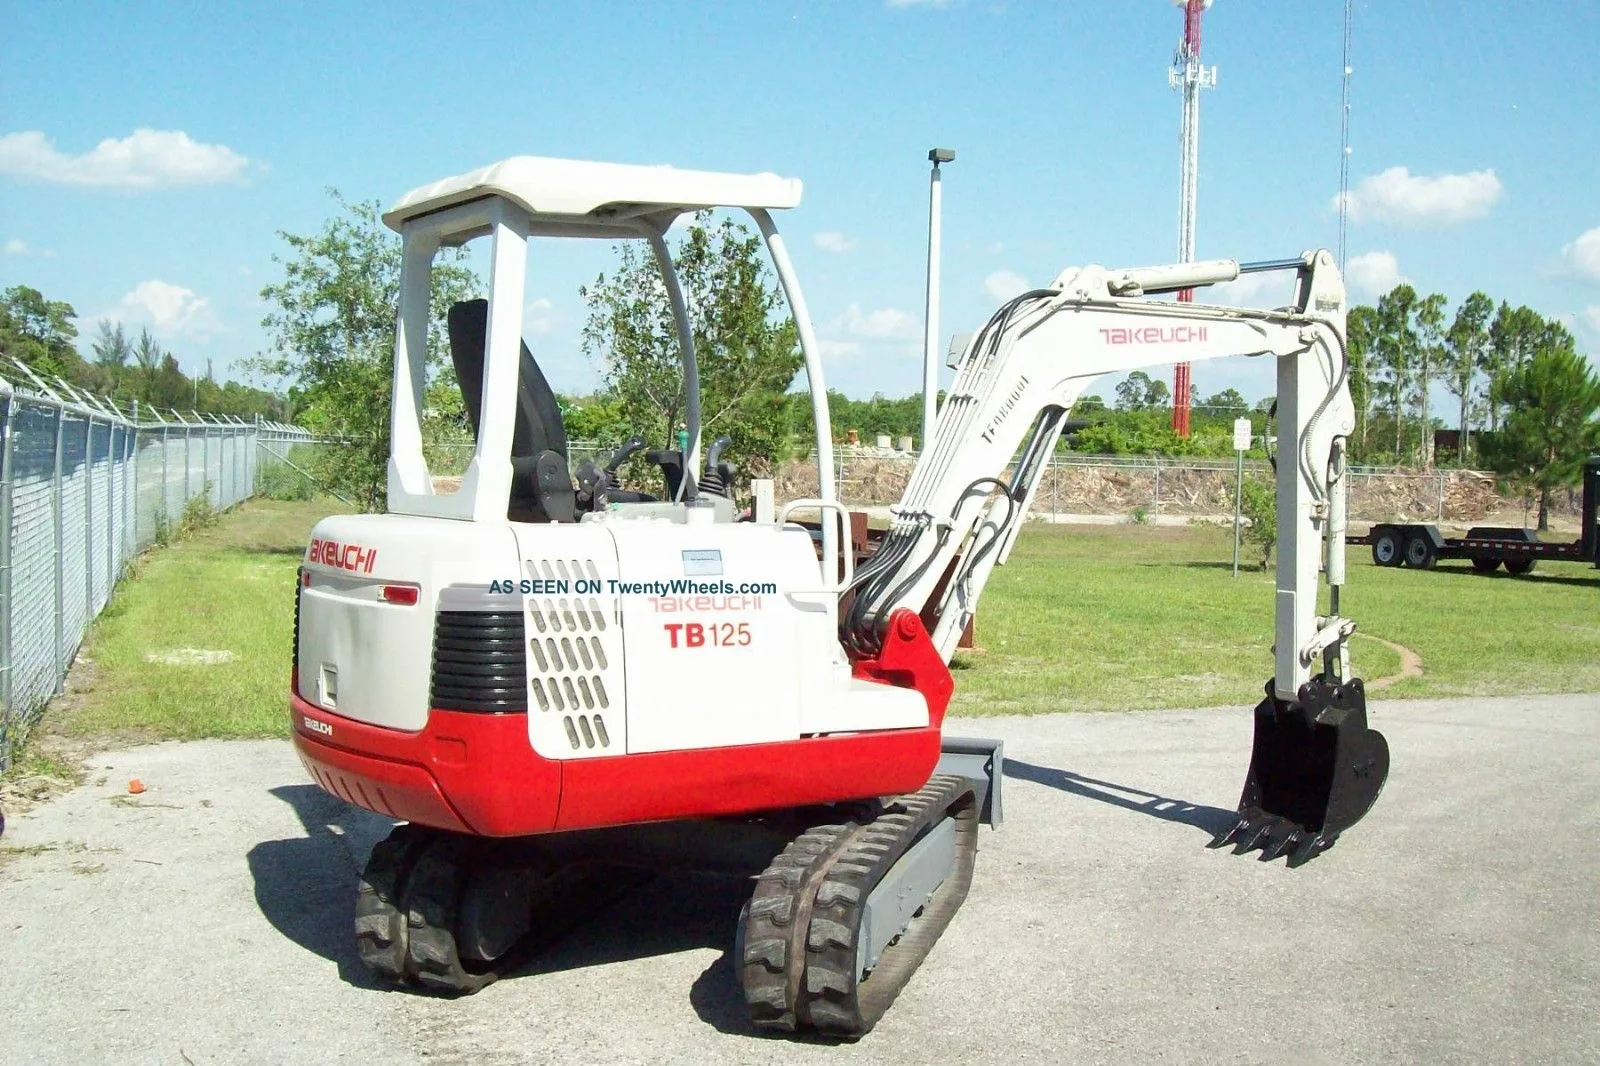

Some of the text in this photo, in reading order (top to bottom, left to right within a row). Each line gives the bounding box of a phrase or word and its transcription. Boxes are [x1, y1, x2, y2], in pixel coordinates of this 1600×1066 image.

[1099, 326, 1208, 345] TAKEUCHI
[310, 538, 377, 574] AKEUCHI
[648, 596, 762, 613] TAKEUCHI
[664, 622, 752, 648] TB125
